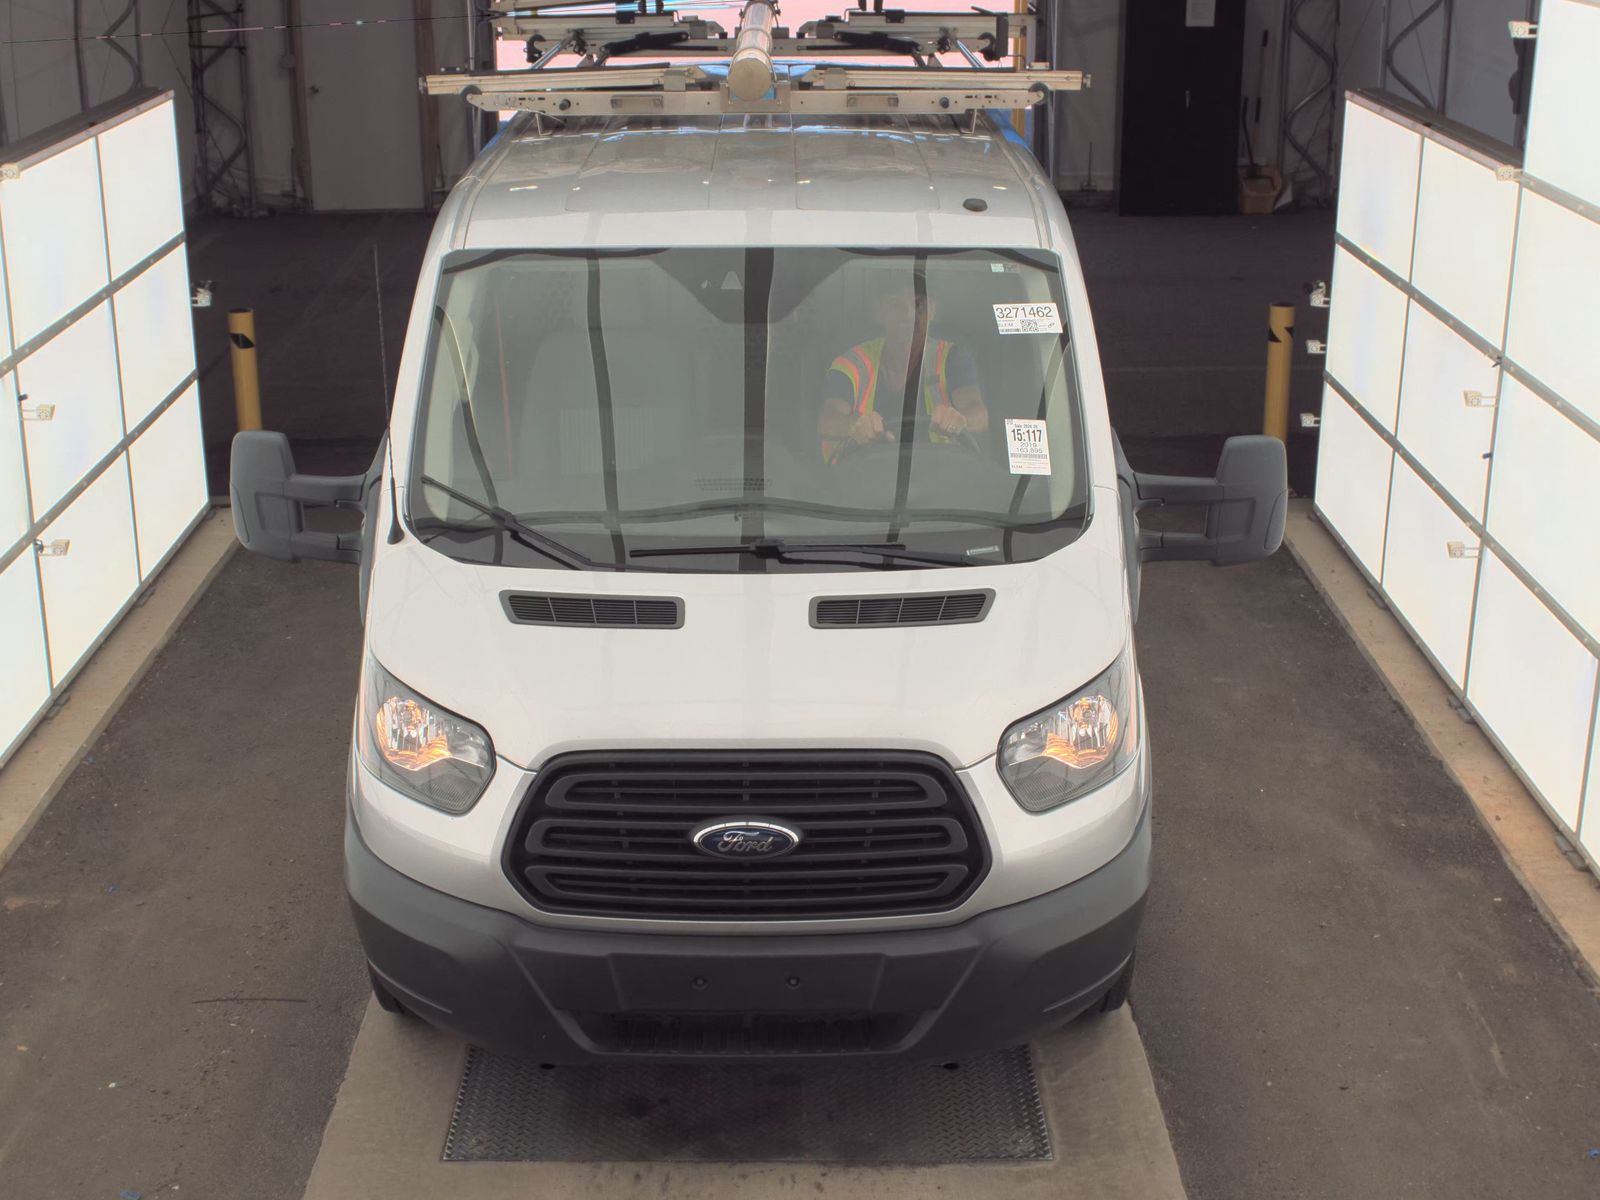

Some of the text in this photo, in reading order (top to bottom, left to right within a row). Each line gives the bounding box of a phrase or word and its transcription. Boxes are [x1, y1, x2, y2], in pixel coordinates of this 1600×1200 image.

[995, 306, 1053, 319] 3271462
[1011, 428, 1042, 442] 15:117
[717, 830, 775, 853] Ford
